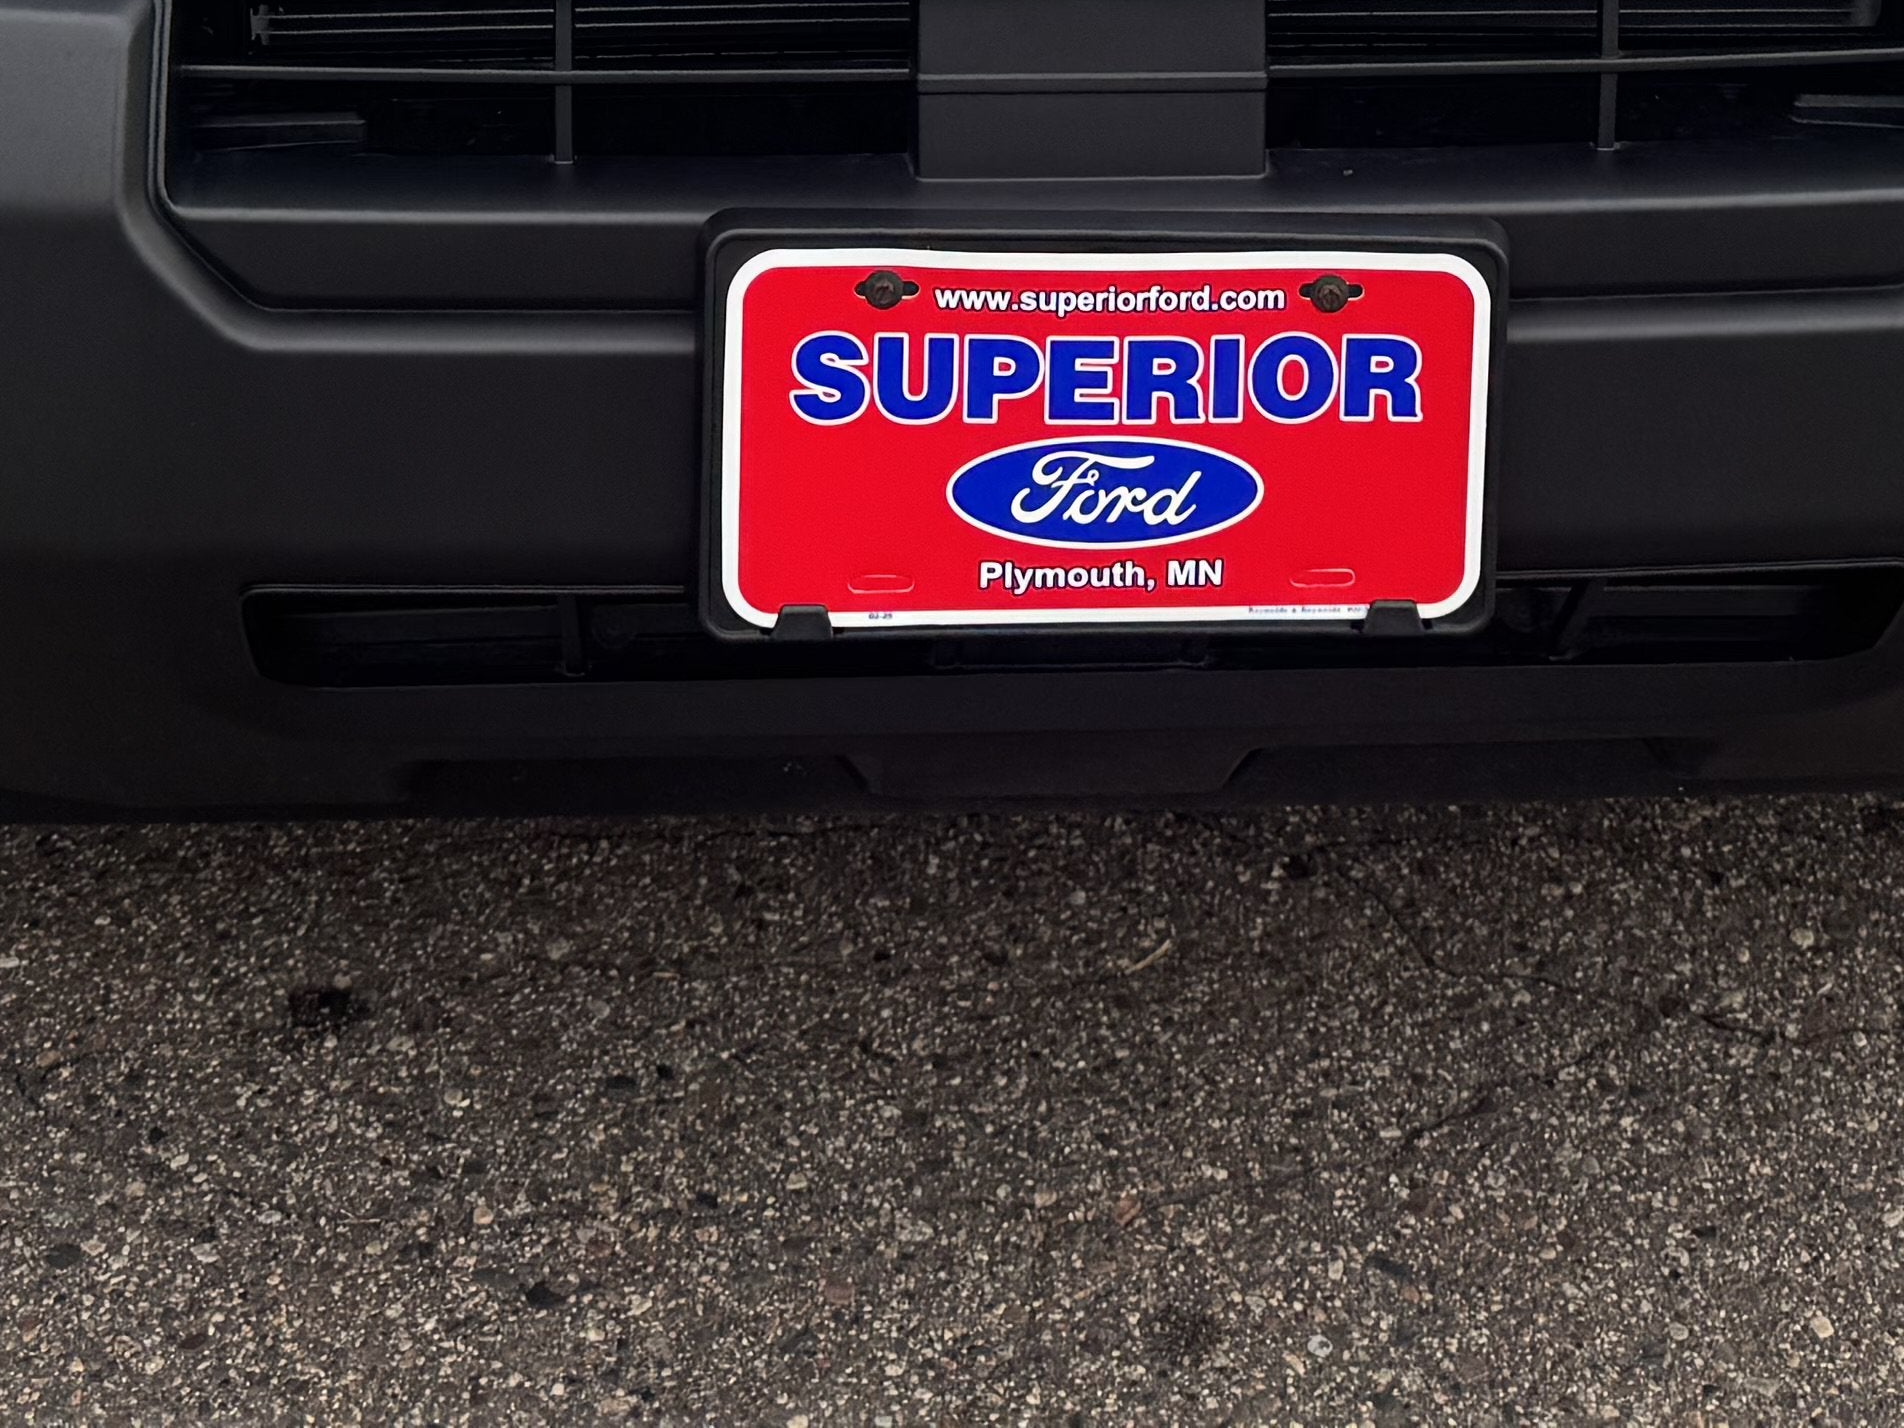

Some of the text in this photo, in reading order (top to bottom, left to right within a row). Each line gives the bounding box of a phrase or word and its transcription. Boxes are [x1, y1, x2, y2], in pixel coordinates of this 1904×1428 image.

[935, 286, 1286, 317] www.superiorford.com
[790, 331, 1423, 425] SUPERIOR
[1010, 450, 1202, 526] Ford
[979, 559, 1223, 594] Plymouth, MN
